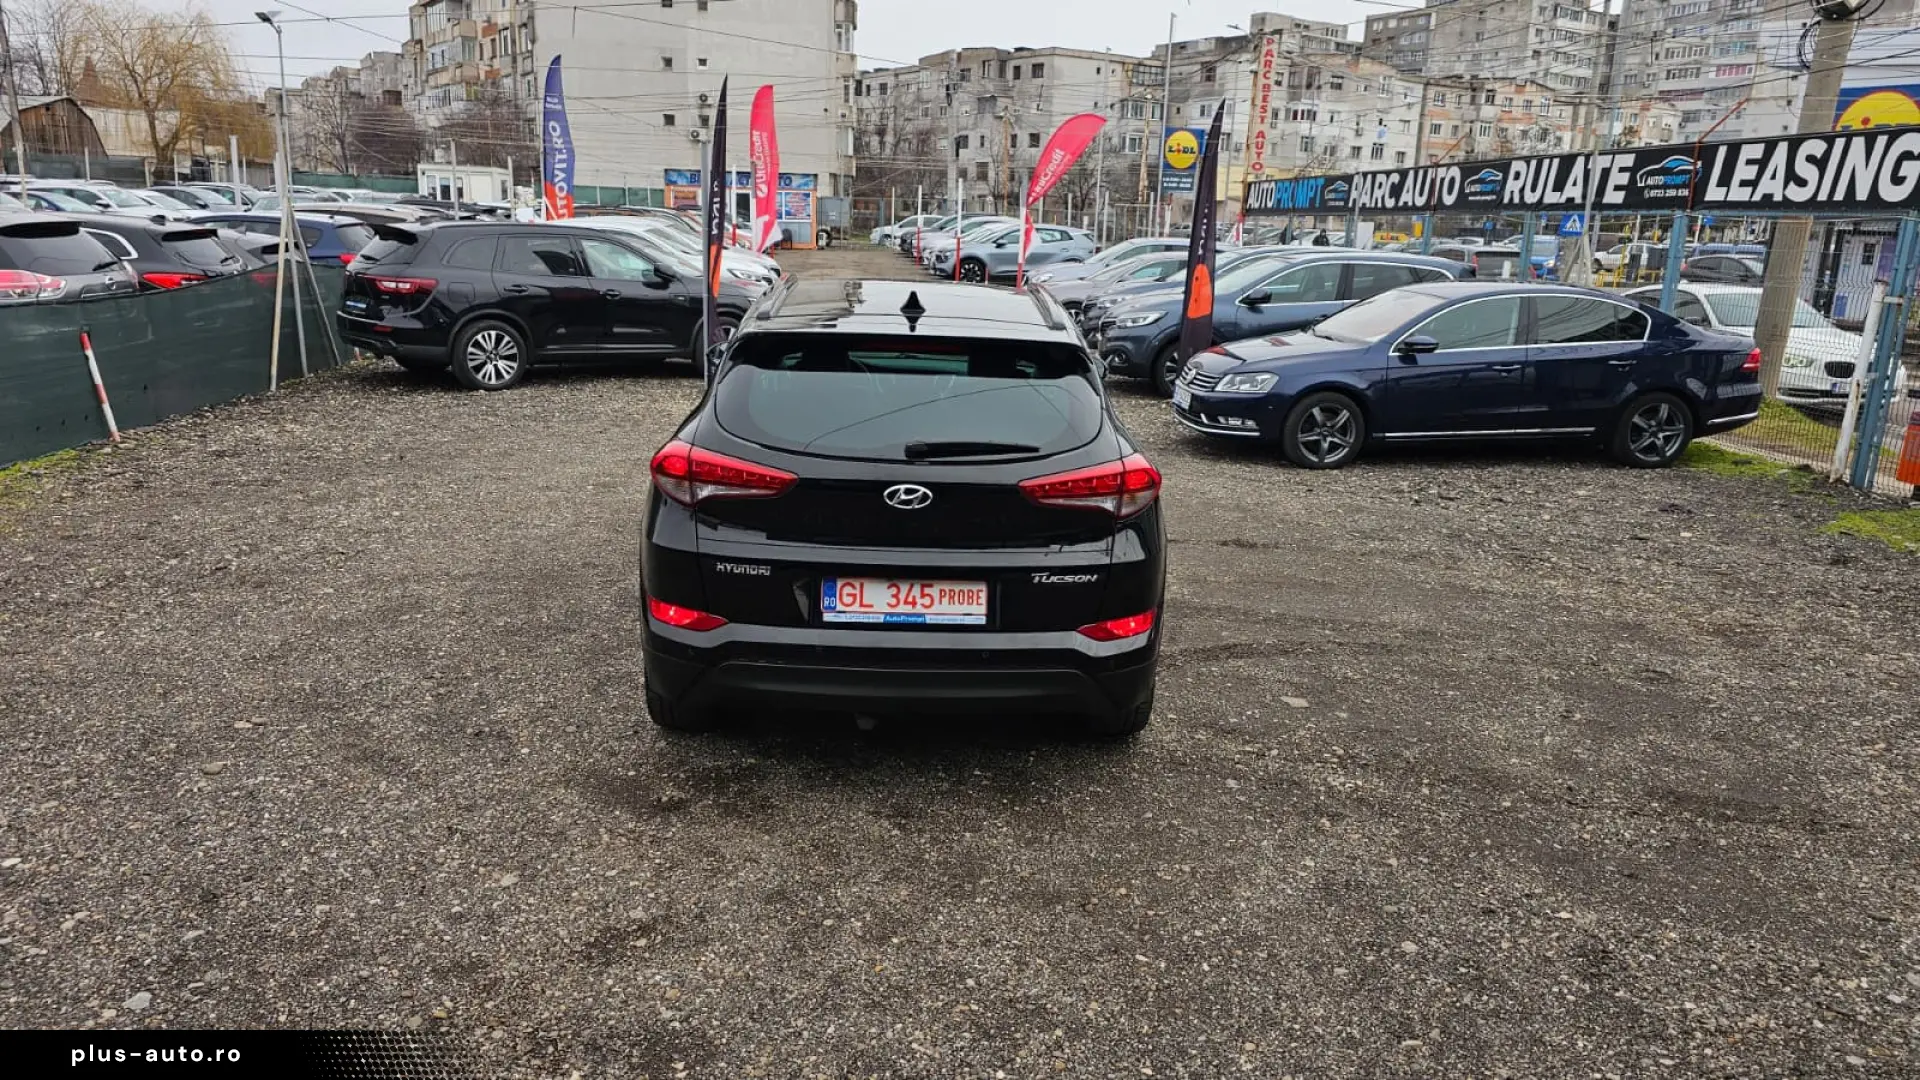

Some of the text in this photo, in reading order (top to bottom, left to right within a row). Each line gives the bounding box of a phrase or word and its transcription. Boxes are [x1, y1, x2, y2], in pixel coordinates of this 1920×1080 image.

[1251, 37, 1276, 172] PARC BEST AUTO
[549, 120, 568, 220] UTOVIT.RO
[1247, 132, 1920, 209] AUTOPROMPT PARC AUTO RULATE LEASING
[716, 562, 771, 576] HYUNDAI
[823, 581, 984, 610] RO GL 345 PROBE
[1031, 572, 1098, 584] TUCSON
